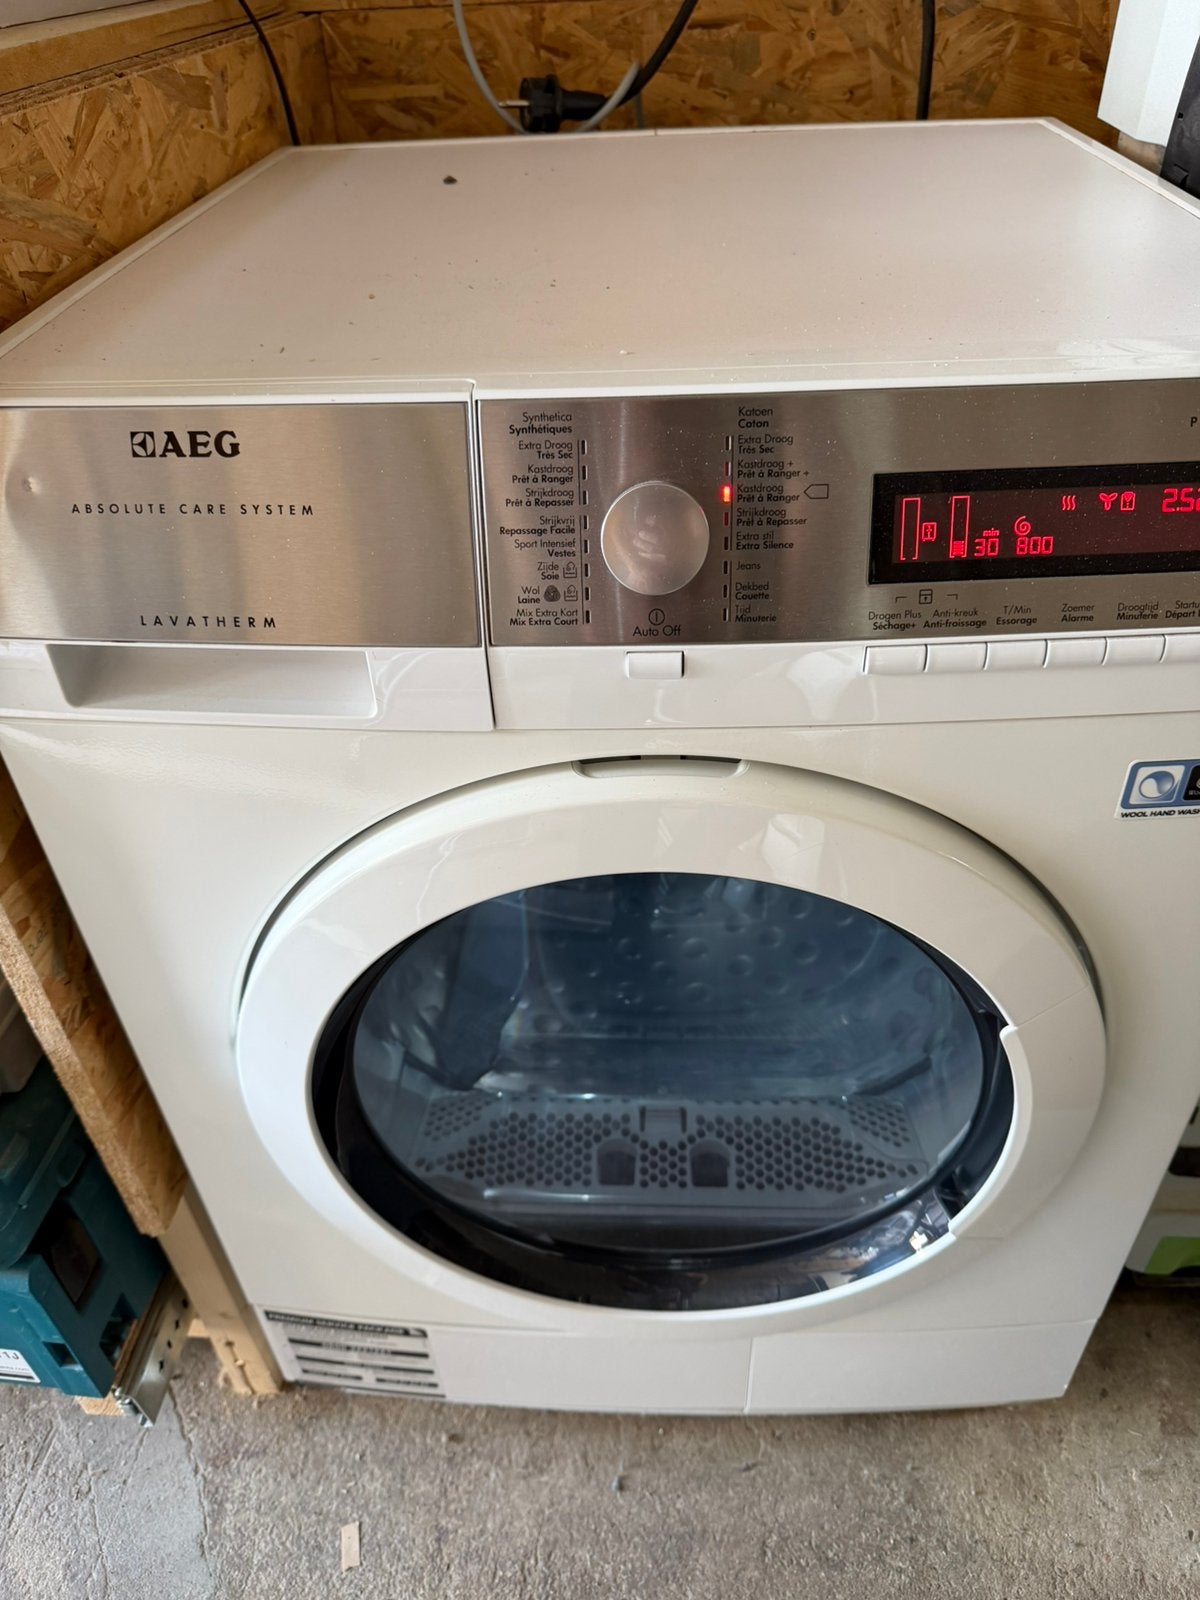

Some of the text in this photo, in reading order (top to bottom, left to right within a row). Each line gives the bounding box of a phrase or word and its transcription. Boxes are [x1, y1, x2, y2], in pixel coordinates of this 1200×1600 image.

[738, 406, 773, 416] Katoen
[522, 412, 572, 423] Synthetica
[738, 419, 769, 428] Coton
[509, 424, 572, 435] Synthétiques
[159, 430, 240, 458] AEG
[738, 435, 793, 445] Extra Droog
[518, 440, 572, 451] Extra Droog
[738, 444, 774, 454] Très Sec
[537, 450, 573, 459] Très Sec
[528, 464, 573, 474] Kastdroog
[737, 459, 784, 470] Kastdroog
[737, 469, 755, 478] Prêt
[758, 468, 764, 478] à
[767, 469, 800, 479] Ranger
[512, 474, 573, 485] Prêt à Ranger
[526, 488, 574, 499] Strijkdroog
[737, 483, 783, 494] Kastdroog
[506, 498, 574, 508] Prêt à Repasser
[737, 493, 800, 503] Prêt à Ranger
[72, 504, 313, 515] ABSOLUTE CARE SYSTEM
[737, 508, 786, 518] Strijkdroog
[540, 516, 575, 527] Strijkvrij
[737, 517, 807, 527] Prêt à Repasser
[500, 526, 575, 536] Repassage Facile
[983, 528, 999, 536] min
[736, 532, 774, 541] Extra stil
[514, 539, 576, 550] Sport Intensief
[736, 541, 794, 550] Extra Silence
[974, 539, 999, 556] 30
[1016, 536, 1053, 556] 800
[547, 549, 576, 557] Vestes
[537, 562, 559, 572] Zijde
[736, 561, 761, 570] Jeans
[541, 572, 559, 580] Soie
[521, 586, 540, 595] Wol
[736, 583, 769, 591] Dekbed
[518, 596, 540, 604] Laine
[735, 592, 769, 600] Couette
[735, 605, 750, 615] Tijd
[1003, 605, 1031, 614] T/Min
[1061, 603, 1095, 612] Zoemer
[1118, 602, 1158, 613] Droogtijd
[517, 609, 577, 617] Mix Extra Kort
[735, 614, 776, 622] Minuterie
[869, 610, 921, 622] Drogen Plus
[933, 608, 978, 618] Anti-kreuk
[1117, 612, 1158, 620] Minuterie
[1165, 610, 1195, 620] Départ
[140, 616, 275, 628] LAVATHERM
[510, 618, 578, 626] Mix Extra Court
[996, 617, 1037, 626] Essorage
[1061, 614, 1094, 623] Alarme
[873, 621, 916, 631] Séchage+
[923, 619, 987, 629] Anti-froissage
[633, 625, 681, 636] Auto Off
